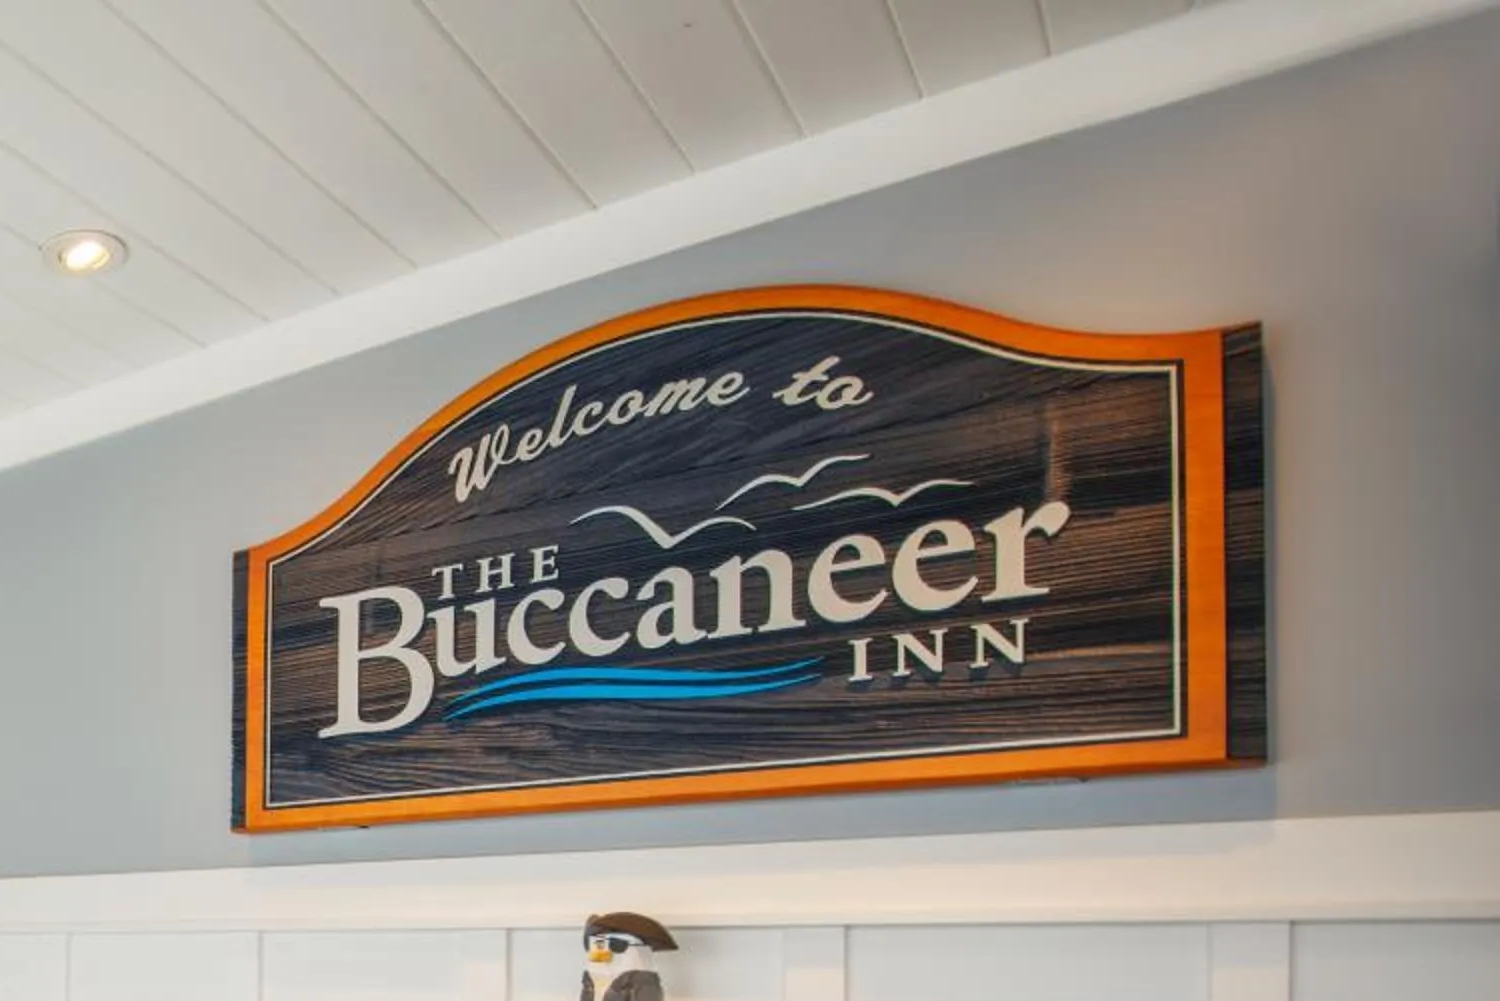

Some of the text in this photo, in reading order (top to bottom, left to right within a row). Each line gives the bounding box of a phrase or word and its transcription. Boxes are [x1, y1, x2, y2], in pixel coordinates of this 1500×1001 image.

[448, 355, 874, 503] Welcome to
[318, 500, 1071, 740] Buccaneer
[432, 545, 560, 600] THE
[848, 619, 1030, 683] INN
